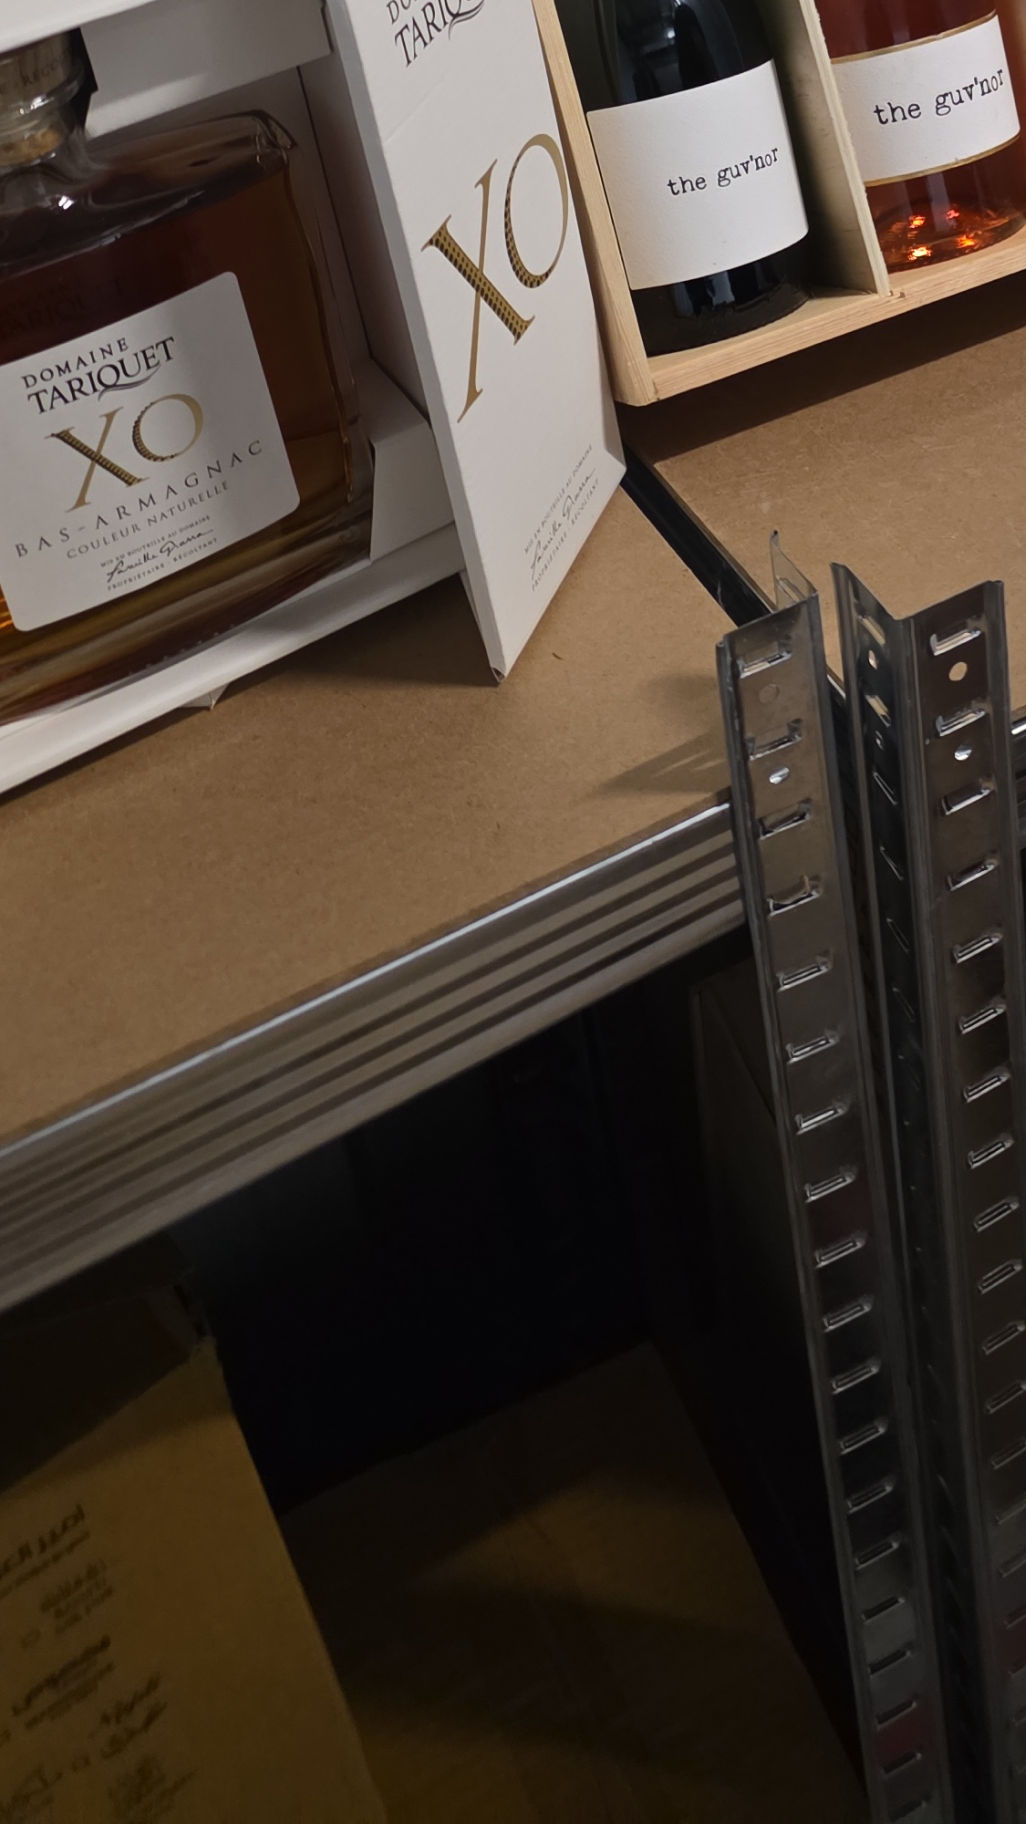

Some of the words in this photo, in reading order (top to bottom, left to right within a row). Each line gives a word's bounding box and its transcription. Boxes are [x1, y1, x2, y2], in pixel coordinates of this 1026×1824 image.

[873, 101, 922, 125] the
[935, 68, 1004, 117] guv'nor
[667, 176, 707, 196] the
[717, 147, 779, 187] guv'nor
[421, 133, 569, 423] XO
[22, 337, 129, 389] DOMAINE
[27, 336, 176, 415] TARIQUET
[45, 393, 204, 514] XO
[14, 439, 263, 559] BAS-ARMAGNAC
[66, 523, 141, 560] COULEUR
[147, 480, 230, 527] NATURELLE
